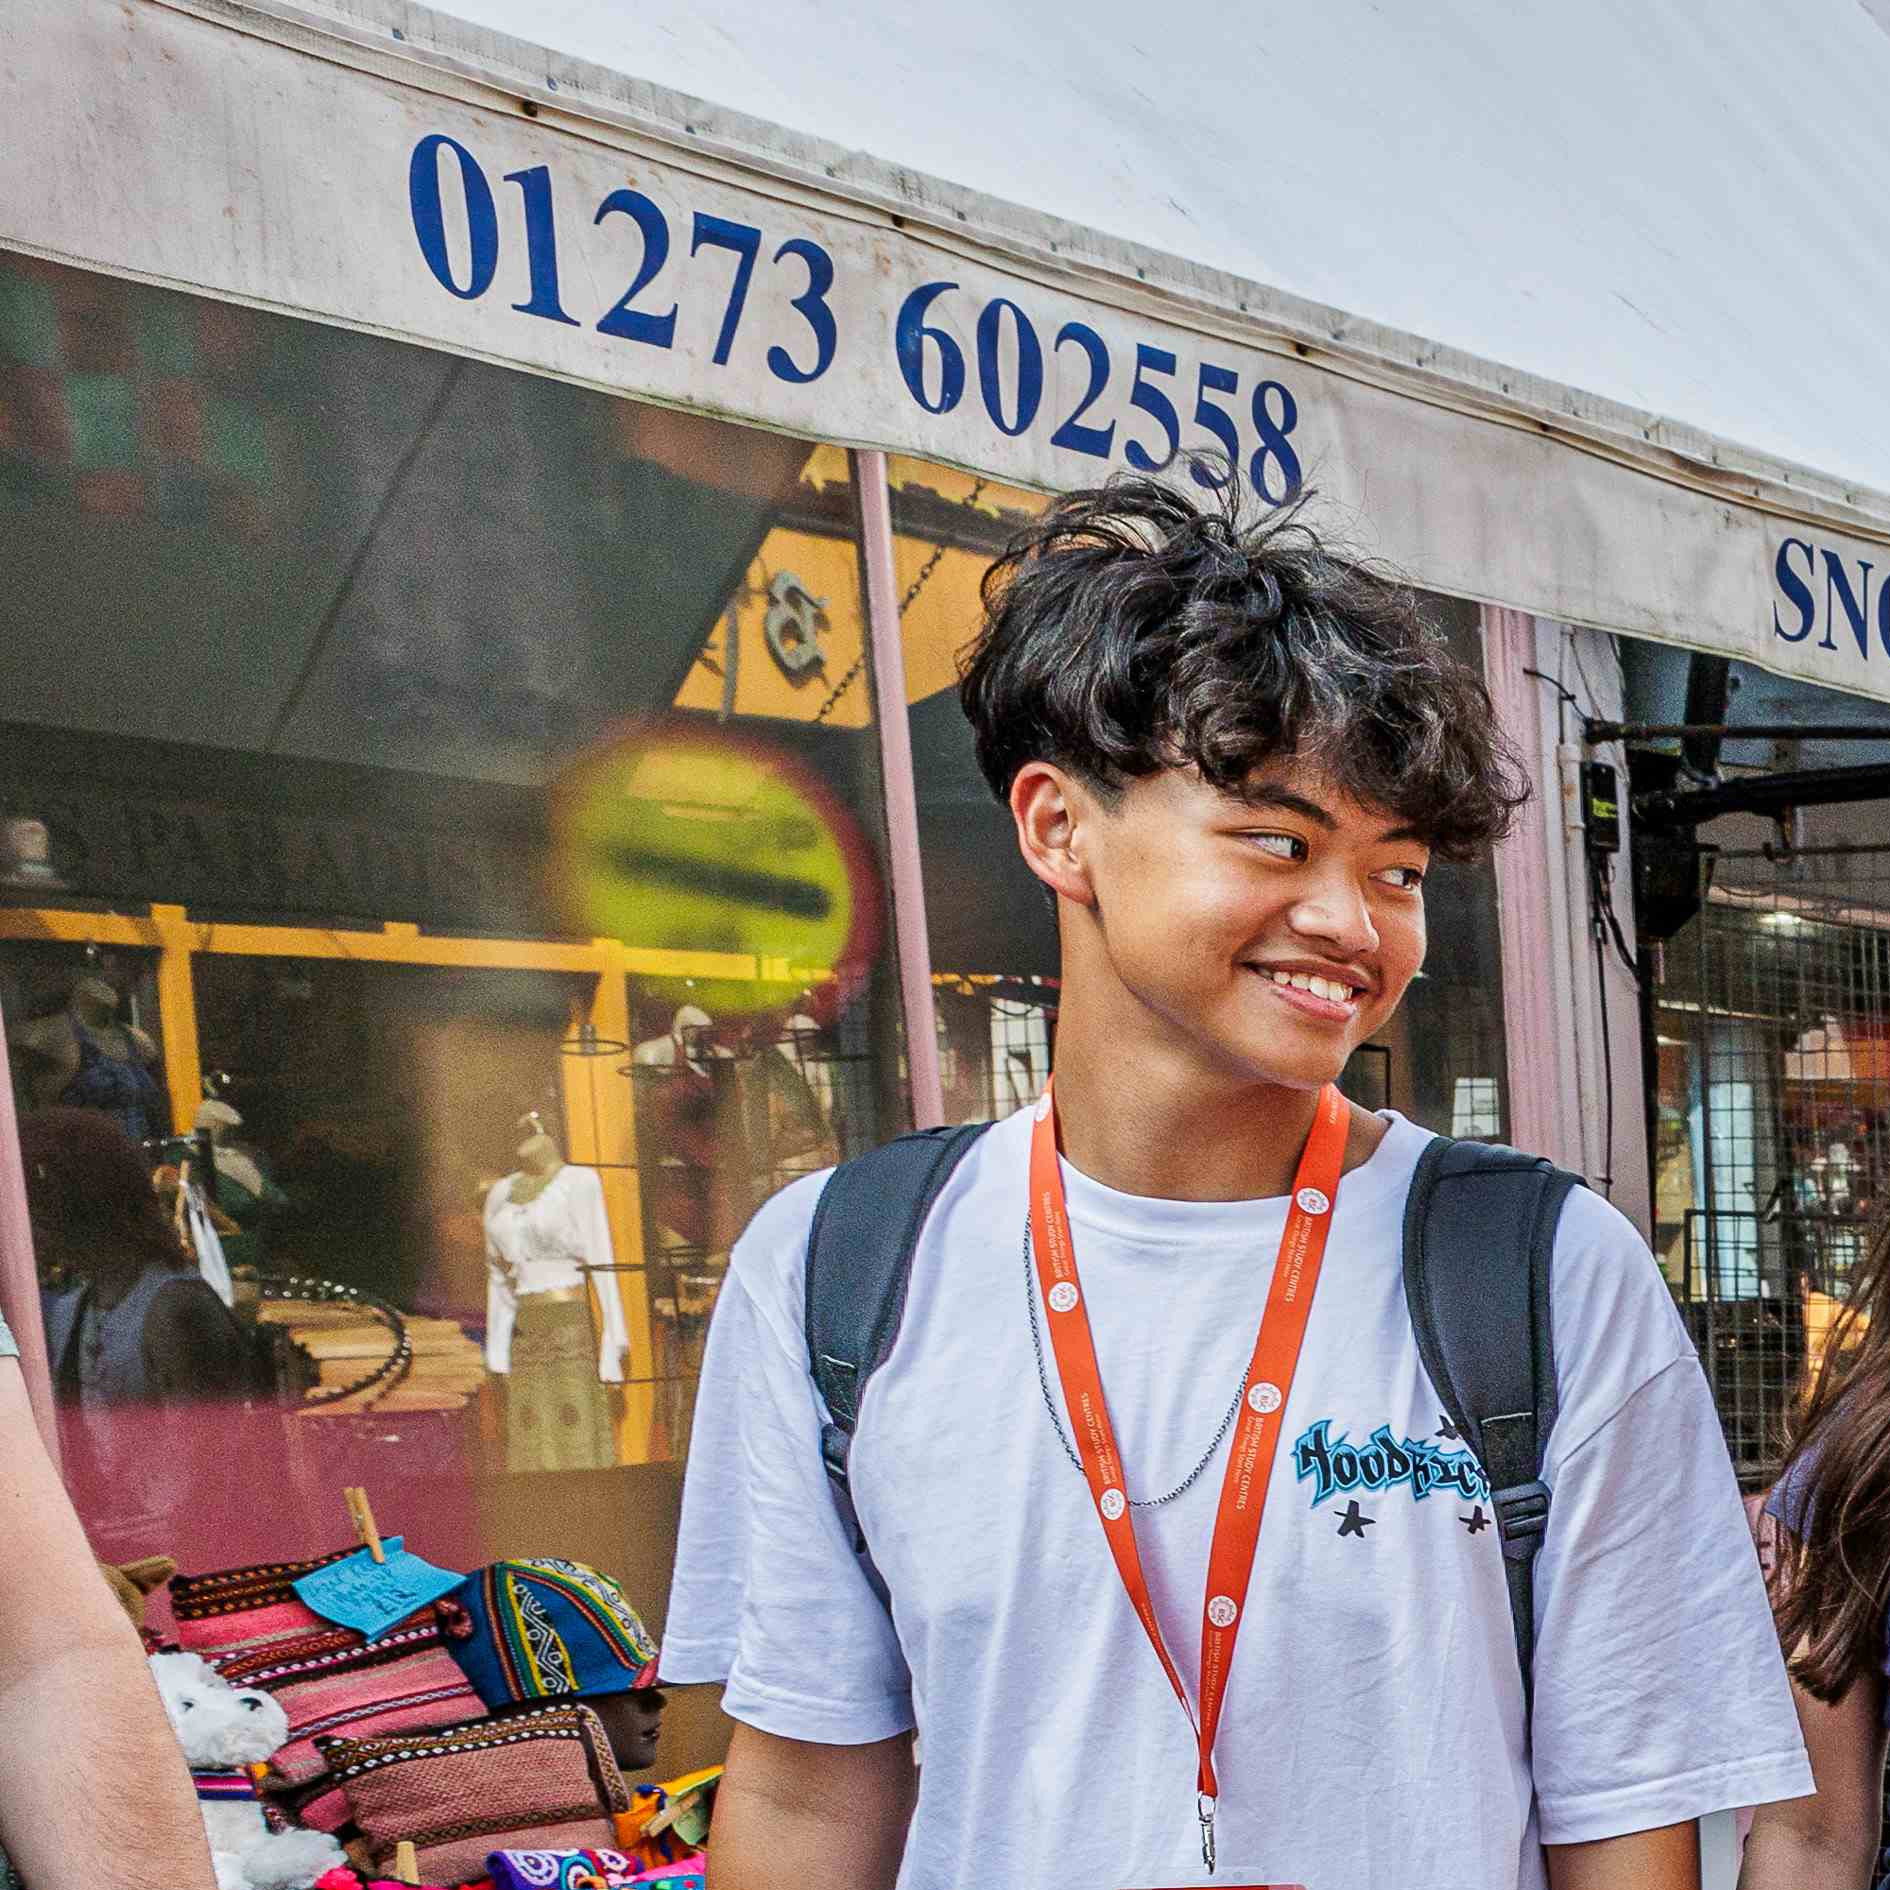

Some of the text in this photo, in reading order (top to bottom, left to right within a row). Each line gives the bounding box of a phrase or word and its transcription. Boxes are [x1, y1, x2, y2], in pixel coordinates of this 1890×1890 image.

[407, 132, 1305, 507] 01273 602558
[1232, 1415, 1266, 1511] BRITISH STUDY CENTRES
